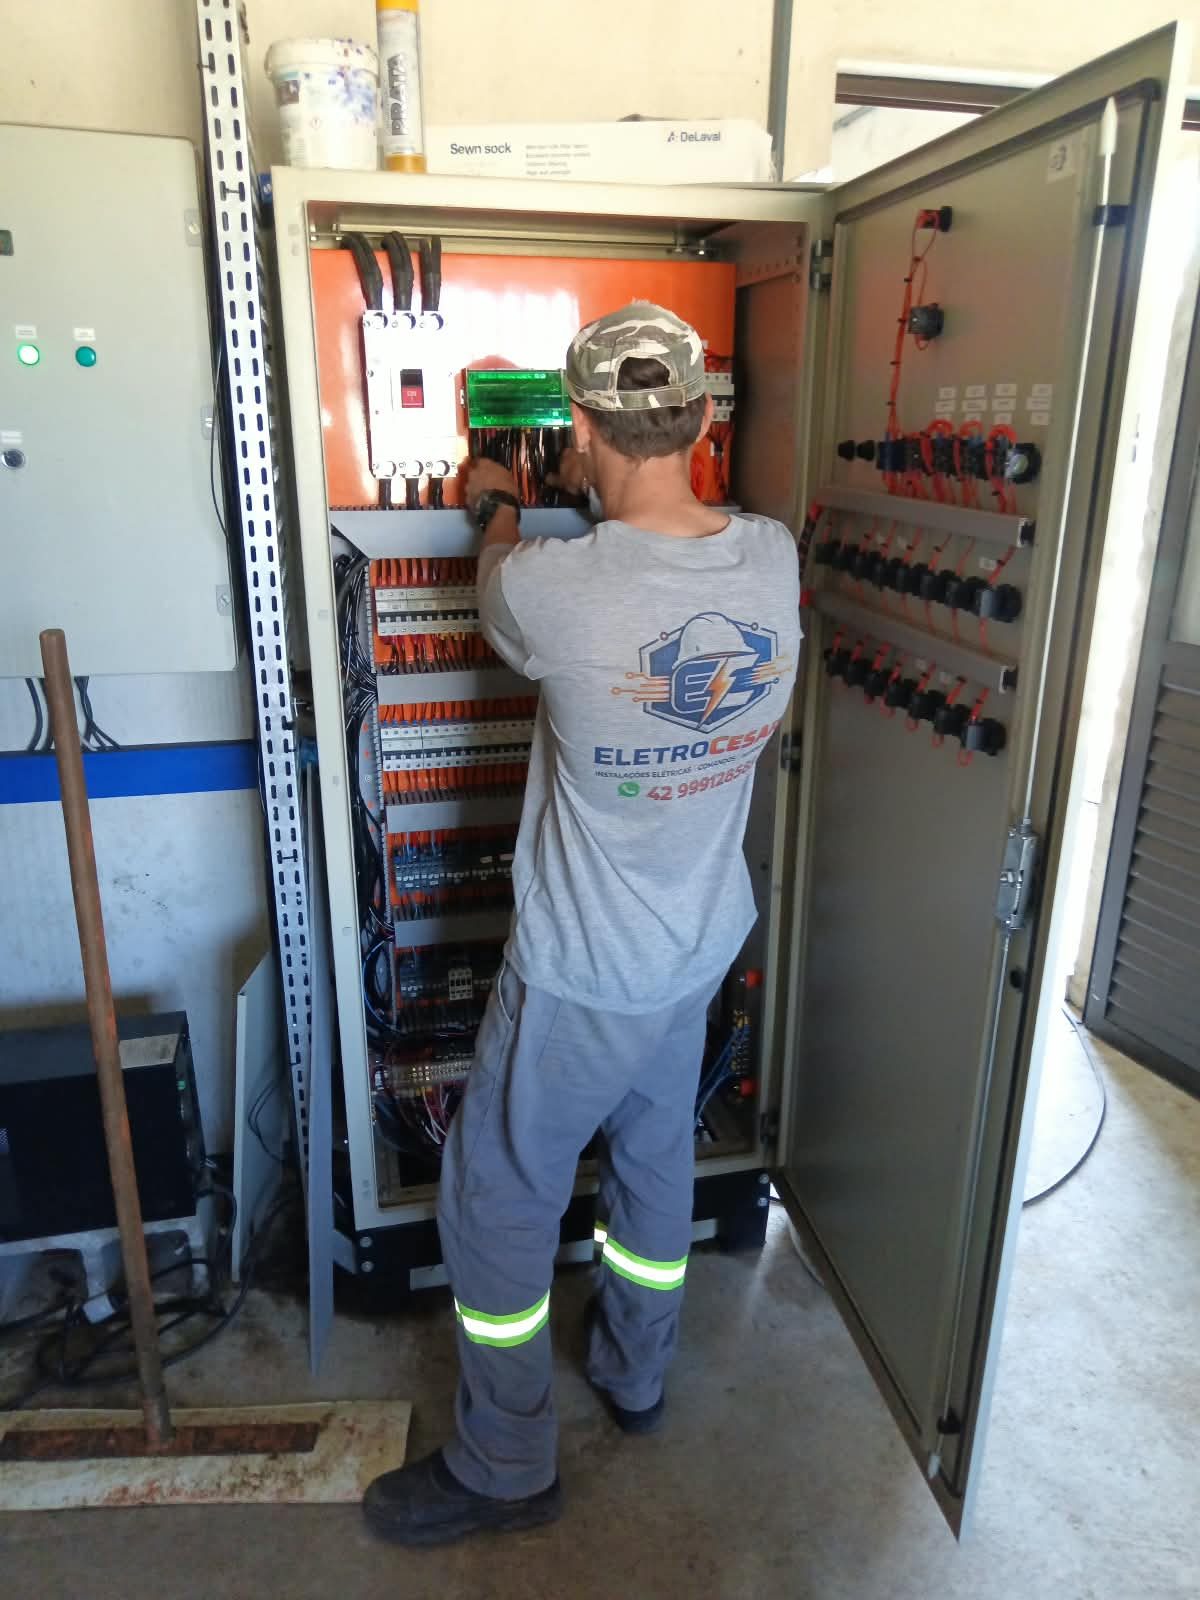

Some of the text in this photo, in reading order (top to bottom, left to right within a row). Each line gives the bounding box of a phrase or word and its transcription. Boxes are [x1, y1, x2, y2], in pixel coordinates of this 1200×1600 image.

[387, 53, 408, 135] PRATA
[680, 131, 720, 142] DeLaval
[450, 143, 481, 155] Sewn
[484, 142, 512, 154] sock
[646, 786, 673, 800] 42
